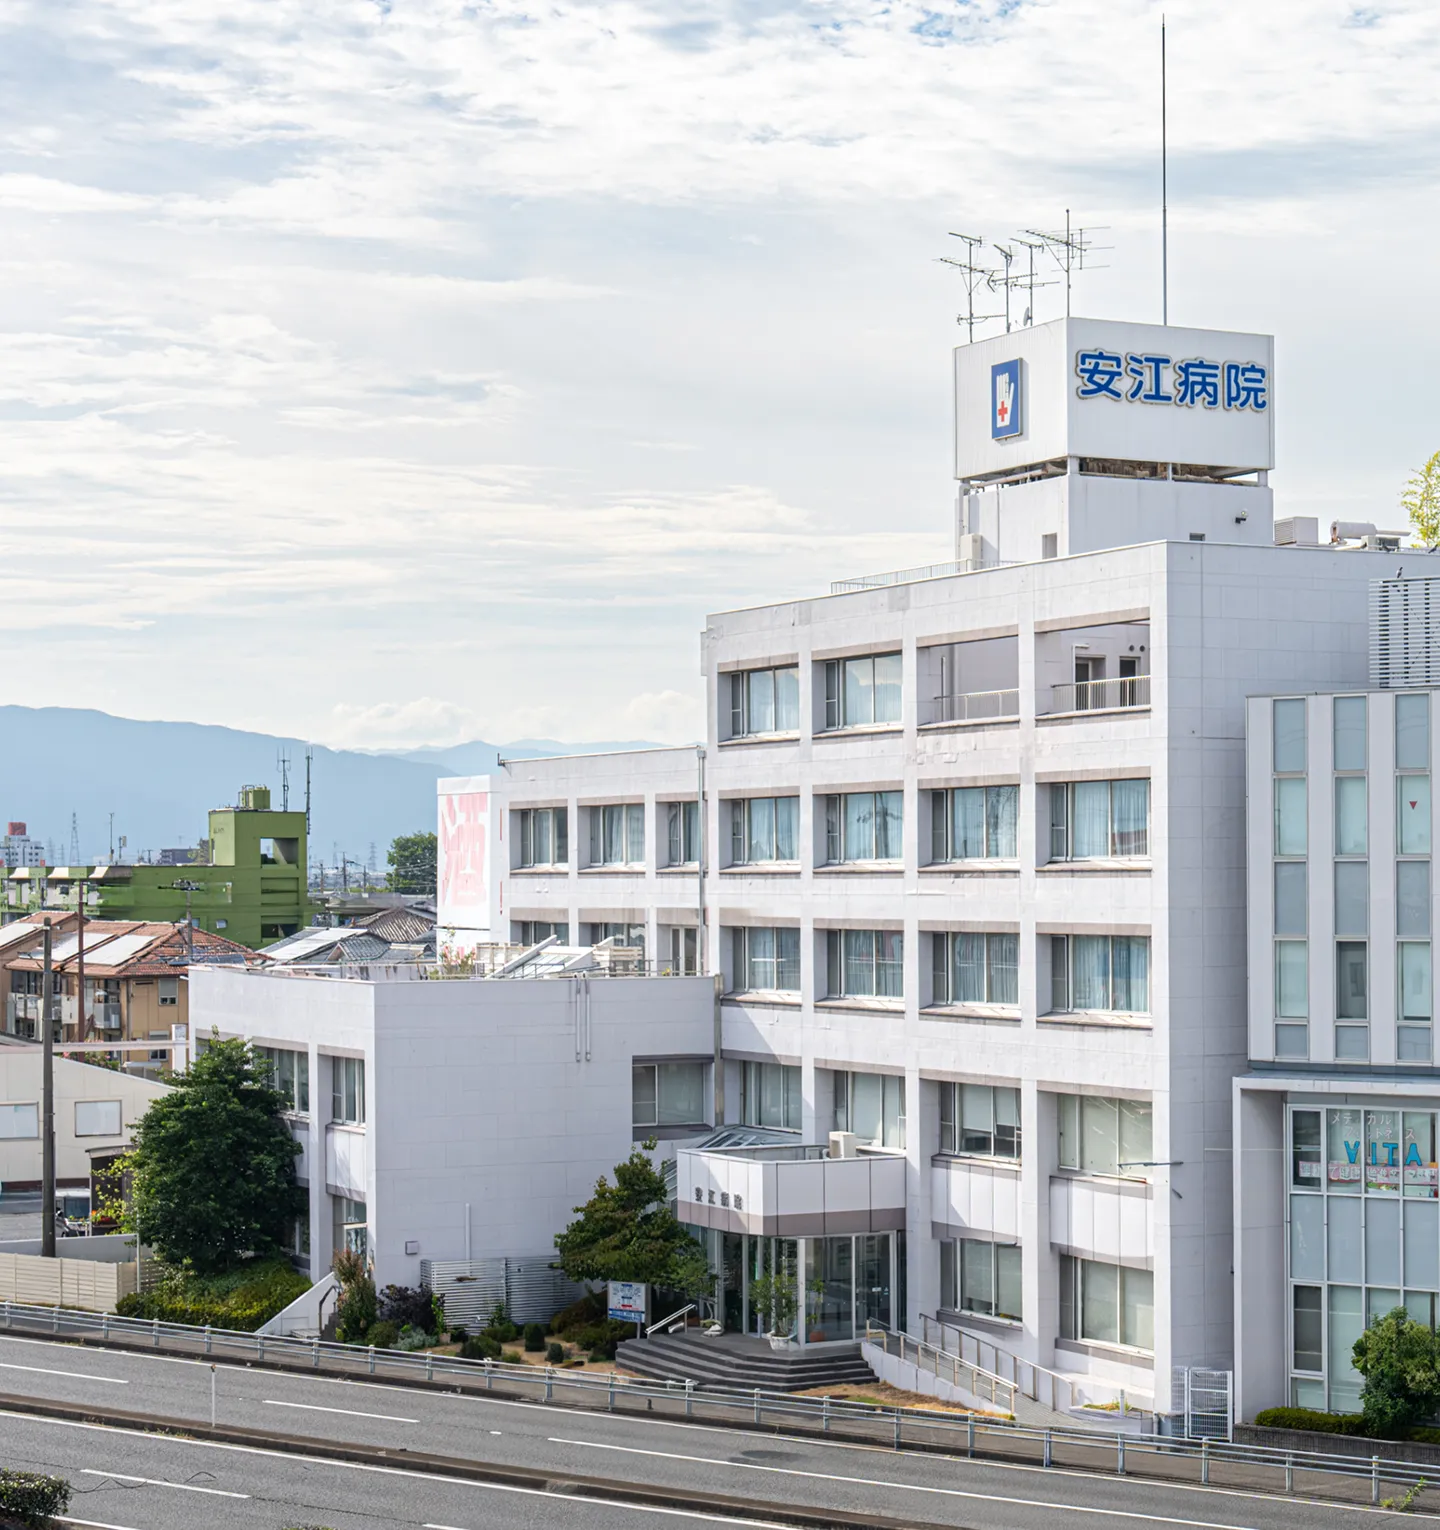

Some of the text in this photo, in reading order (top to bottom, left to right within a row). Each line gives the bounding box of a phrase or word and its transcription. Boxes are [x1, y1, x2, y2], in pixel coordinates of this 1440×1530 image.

[1078, 350, 1267, 411] 安江病院
[1343, 1140, 1423, 1167] VITA
